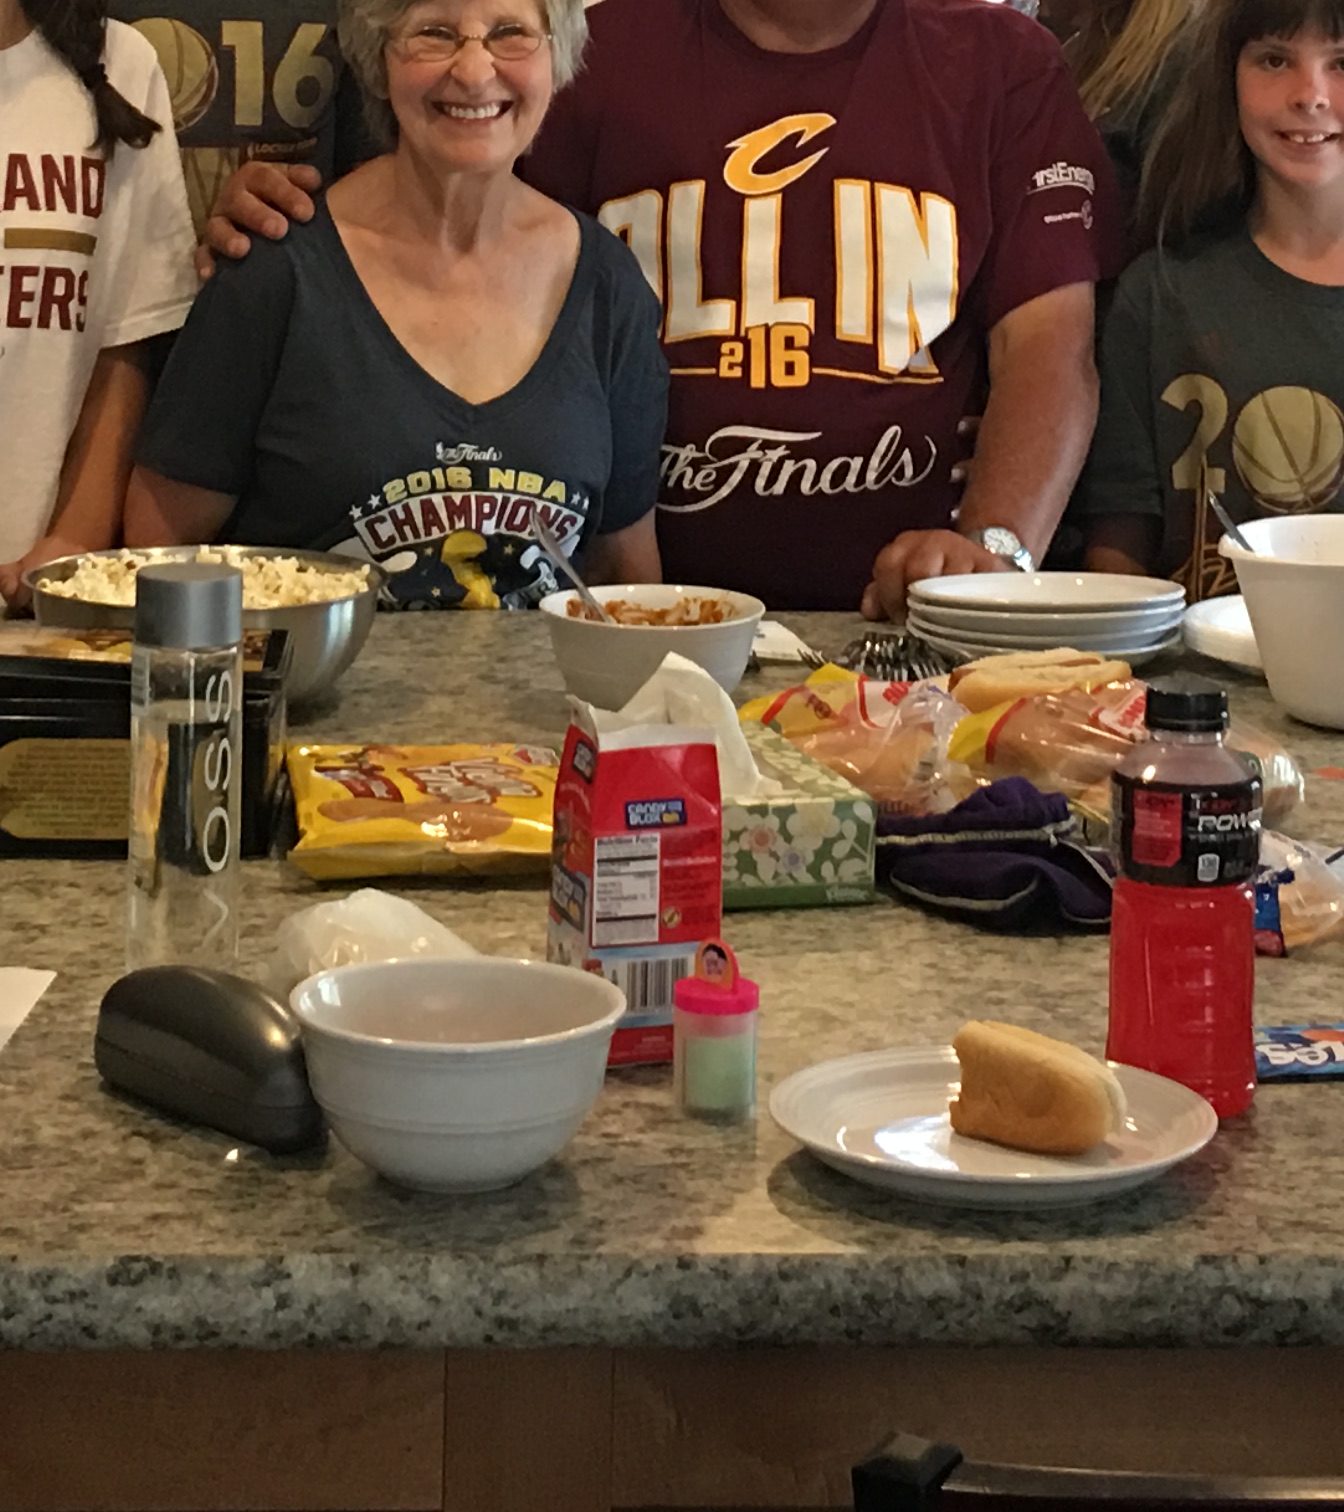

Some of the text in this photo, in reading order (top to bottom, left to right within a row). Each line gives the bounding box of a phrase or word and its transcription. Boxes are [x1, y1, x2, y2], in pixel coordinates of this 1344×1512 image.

[833, 178, 959, 375] IN
[719, 323, 811, 389] 216
[383, 466, 567, 504] 2016 NBA
[657, 425, 938, 510] The Finals
[364, 493, 578, 550] CHAMPIONS
[203, 670, 233, 947] VOSS
